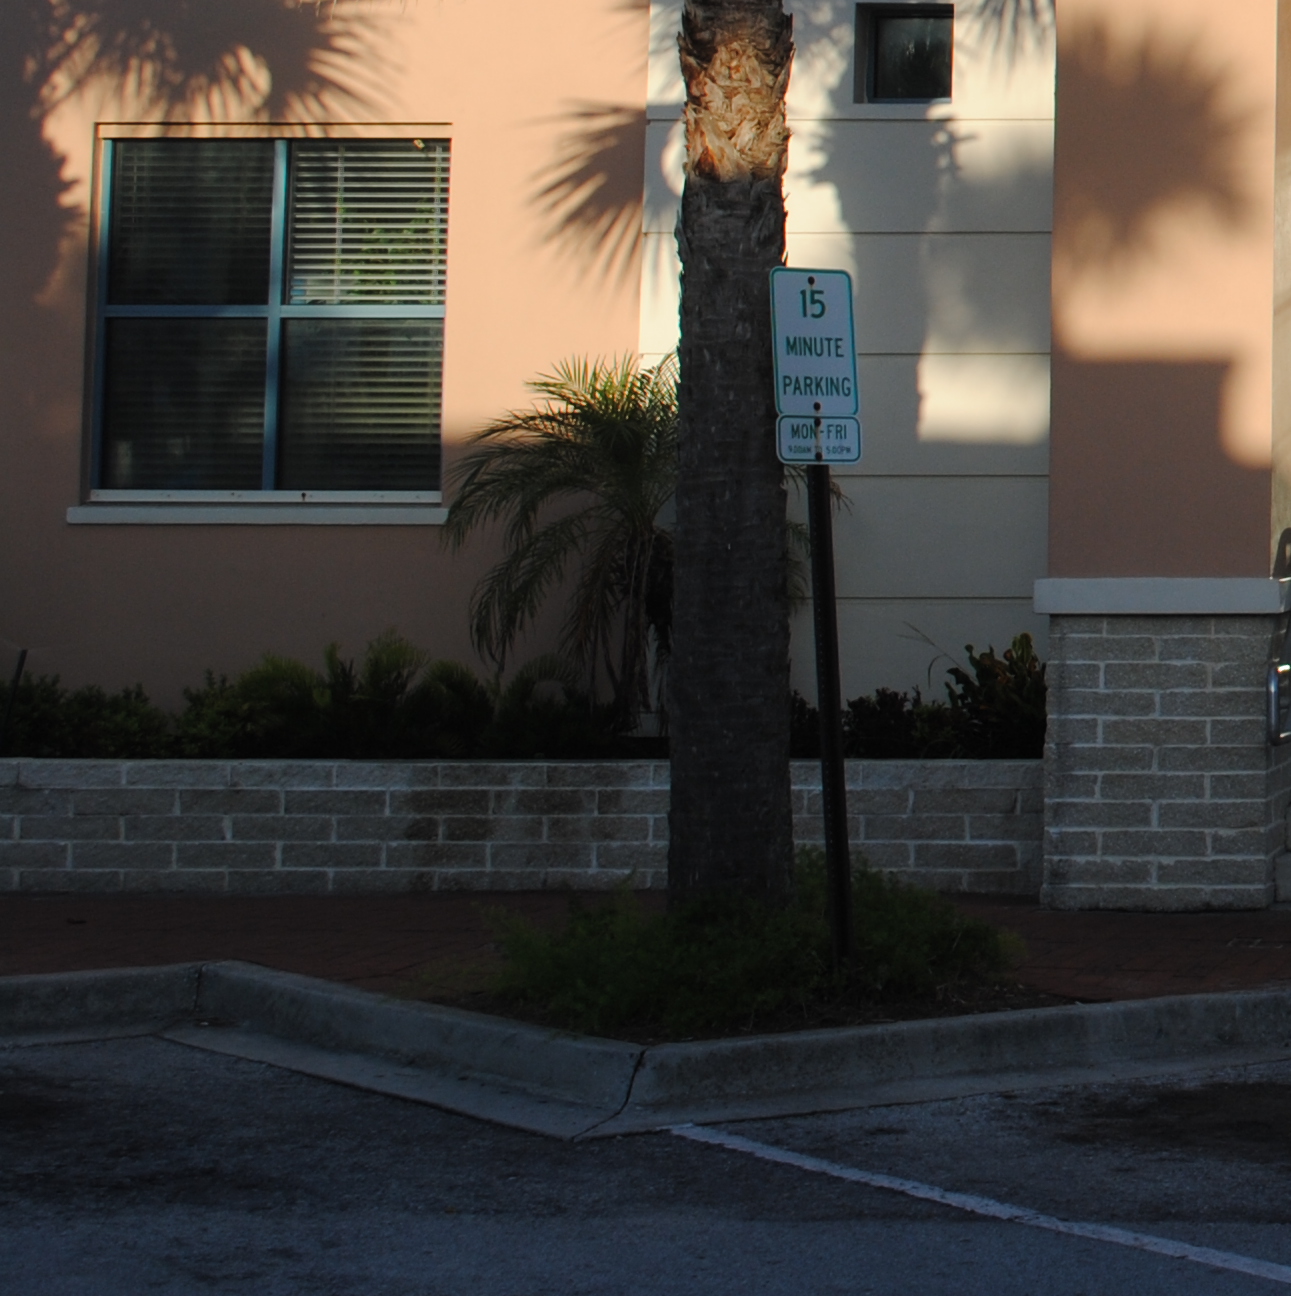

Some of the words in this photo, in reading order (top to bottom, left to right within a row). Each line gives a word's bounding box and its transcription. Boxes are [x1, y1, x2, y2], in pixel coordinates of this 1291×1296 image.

[800, 289, 826, 319] 15
[786, 336, 844, 357] MINUTE
[783, 375, 851, 397] PARKING
